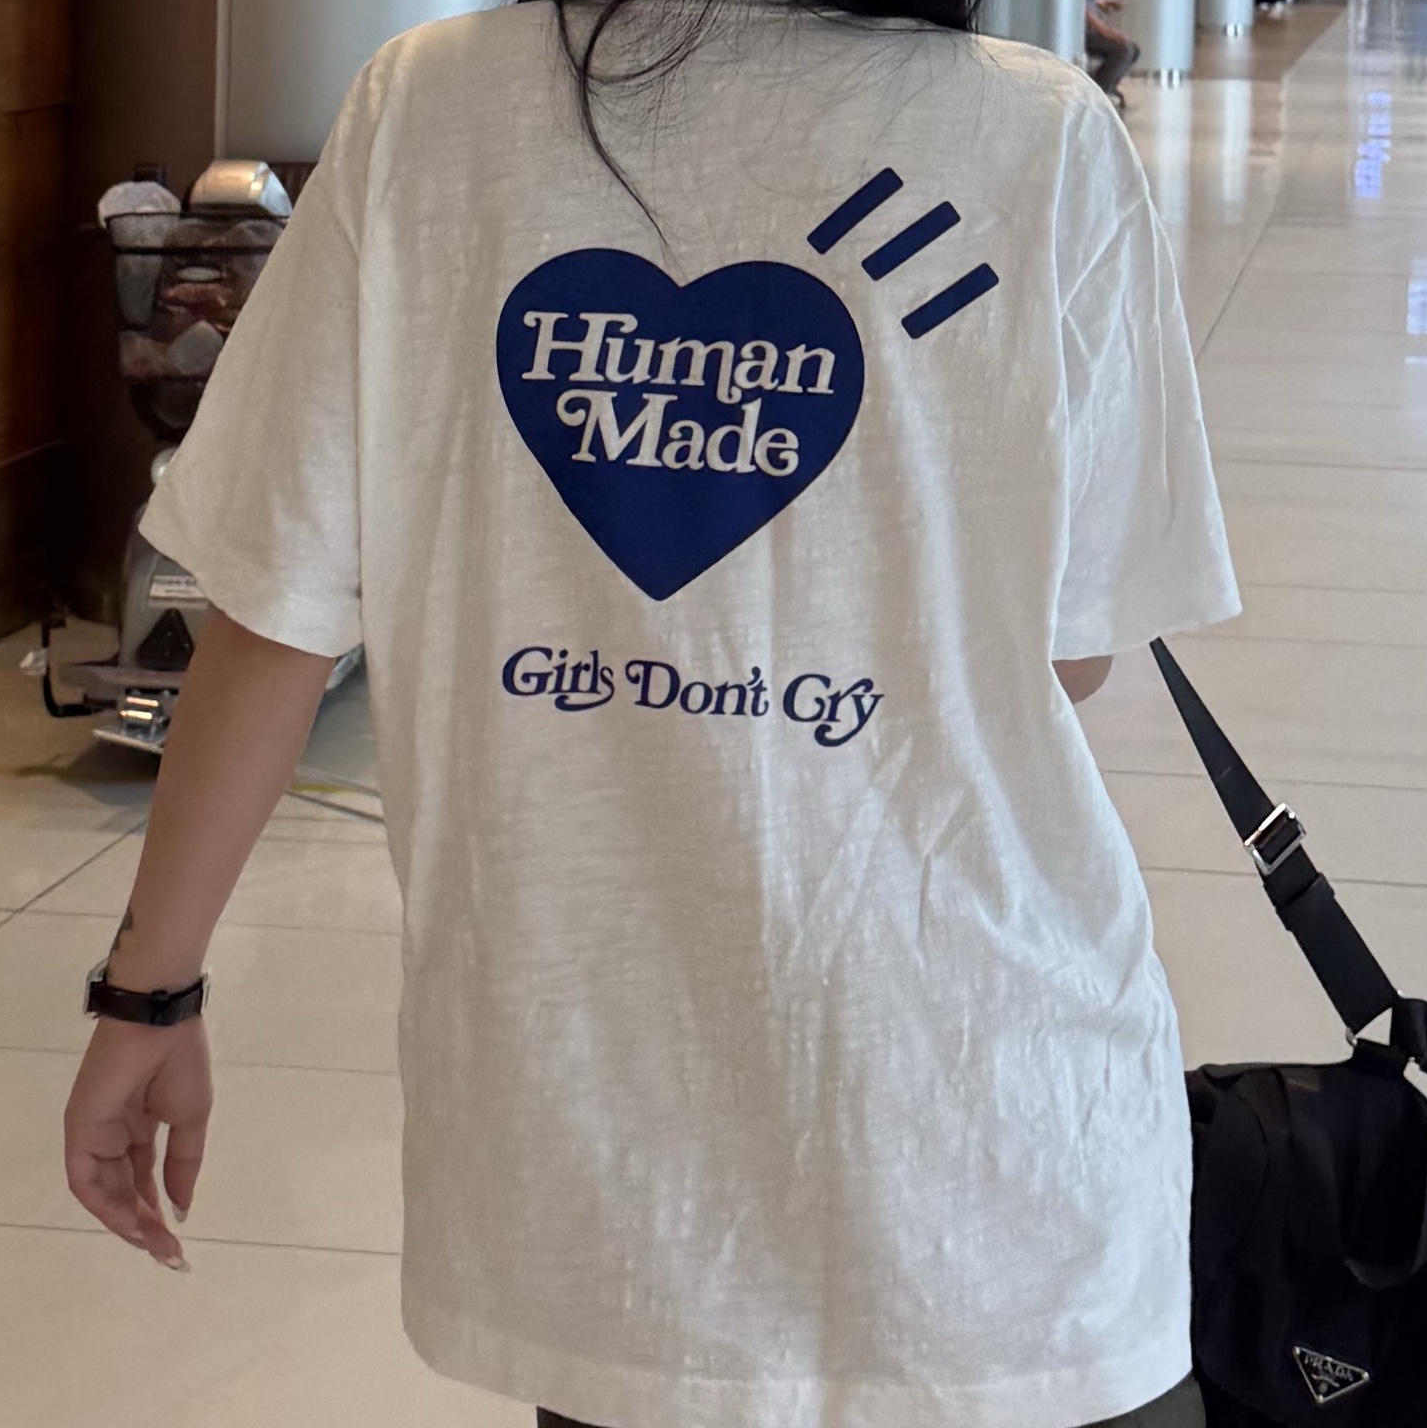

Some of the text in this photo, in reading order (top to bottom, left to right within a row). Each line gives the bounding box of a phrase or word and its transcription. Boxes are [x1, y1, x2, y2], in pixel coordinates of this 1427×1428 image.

[522, 311, 836, 404] Human
[556, 389, 800, 477] Made
[502, 646, 885, 748] Girls Don't Cry
[1303, 1353, 1355, 1382] PRADA
